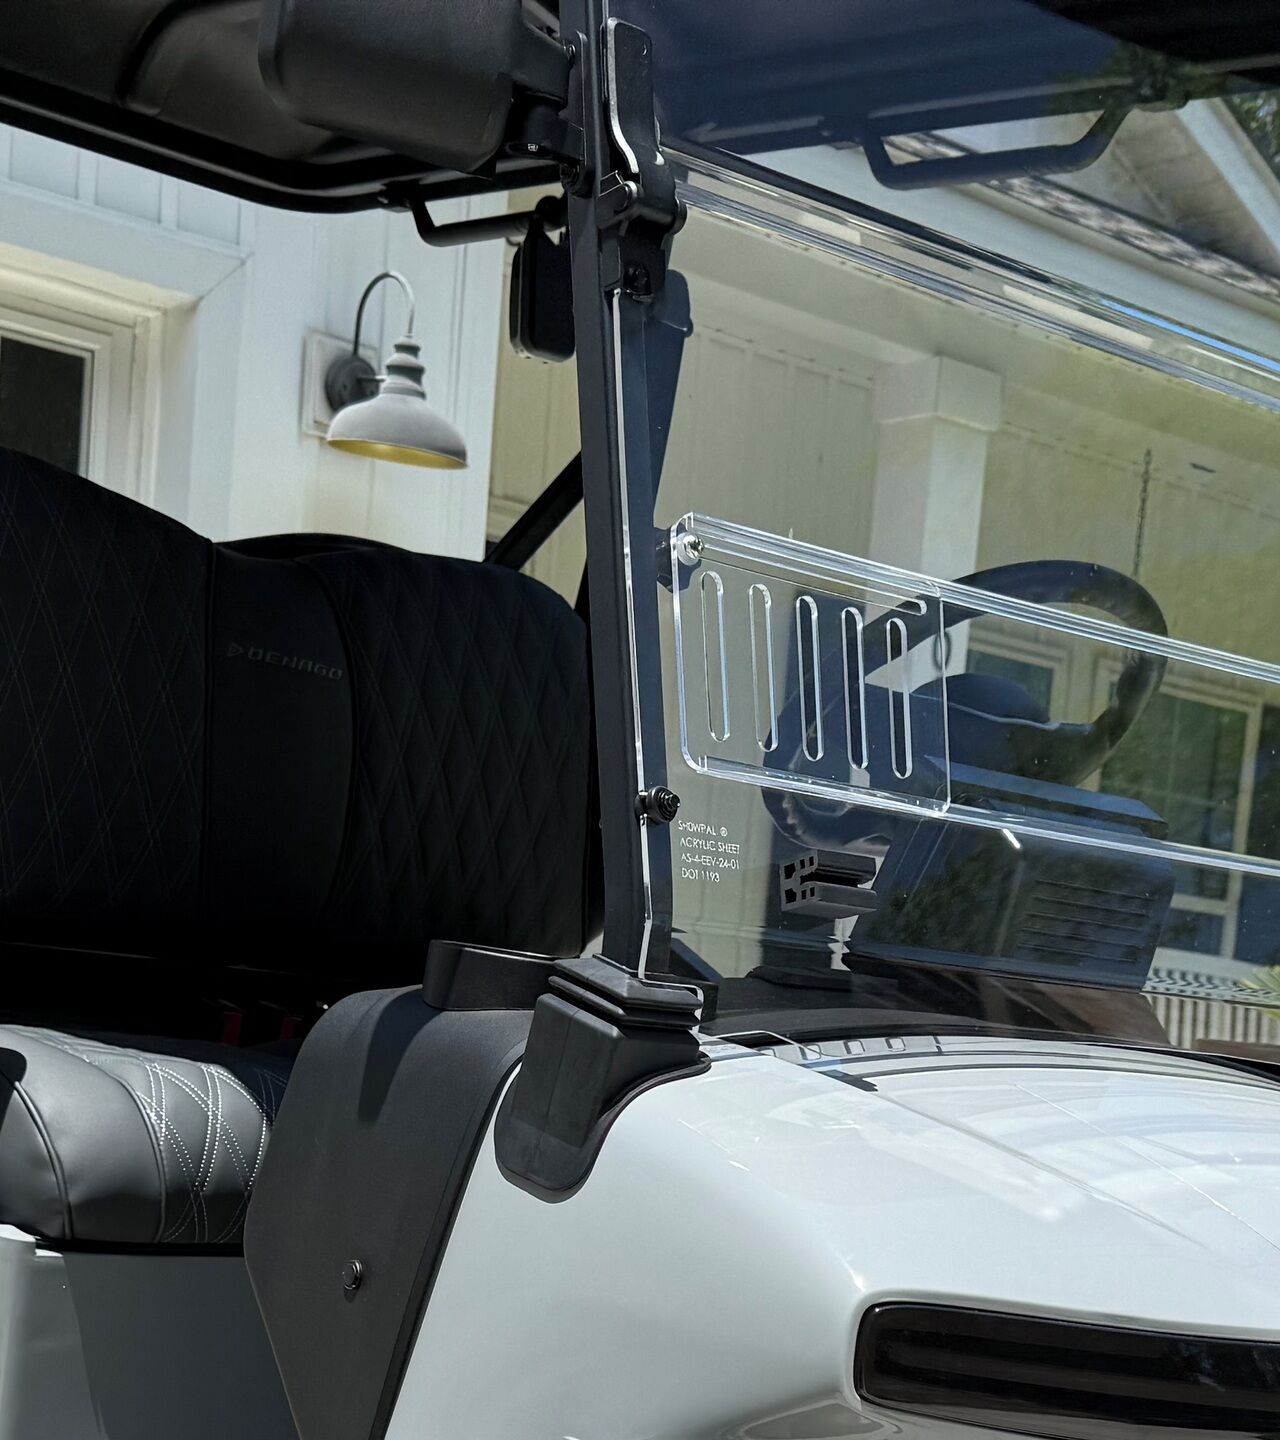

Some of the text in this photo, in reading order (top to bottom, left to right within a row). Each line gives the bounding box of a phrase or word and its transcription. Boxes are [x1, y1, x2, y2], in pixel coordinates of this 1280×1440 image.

[680, 837, 740, 854] ACRYLIC SHEET
[681, 868, 699, 880] DOT
